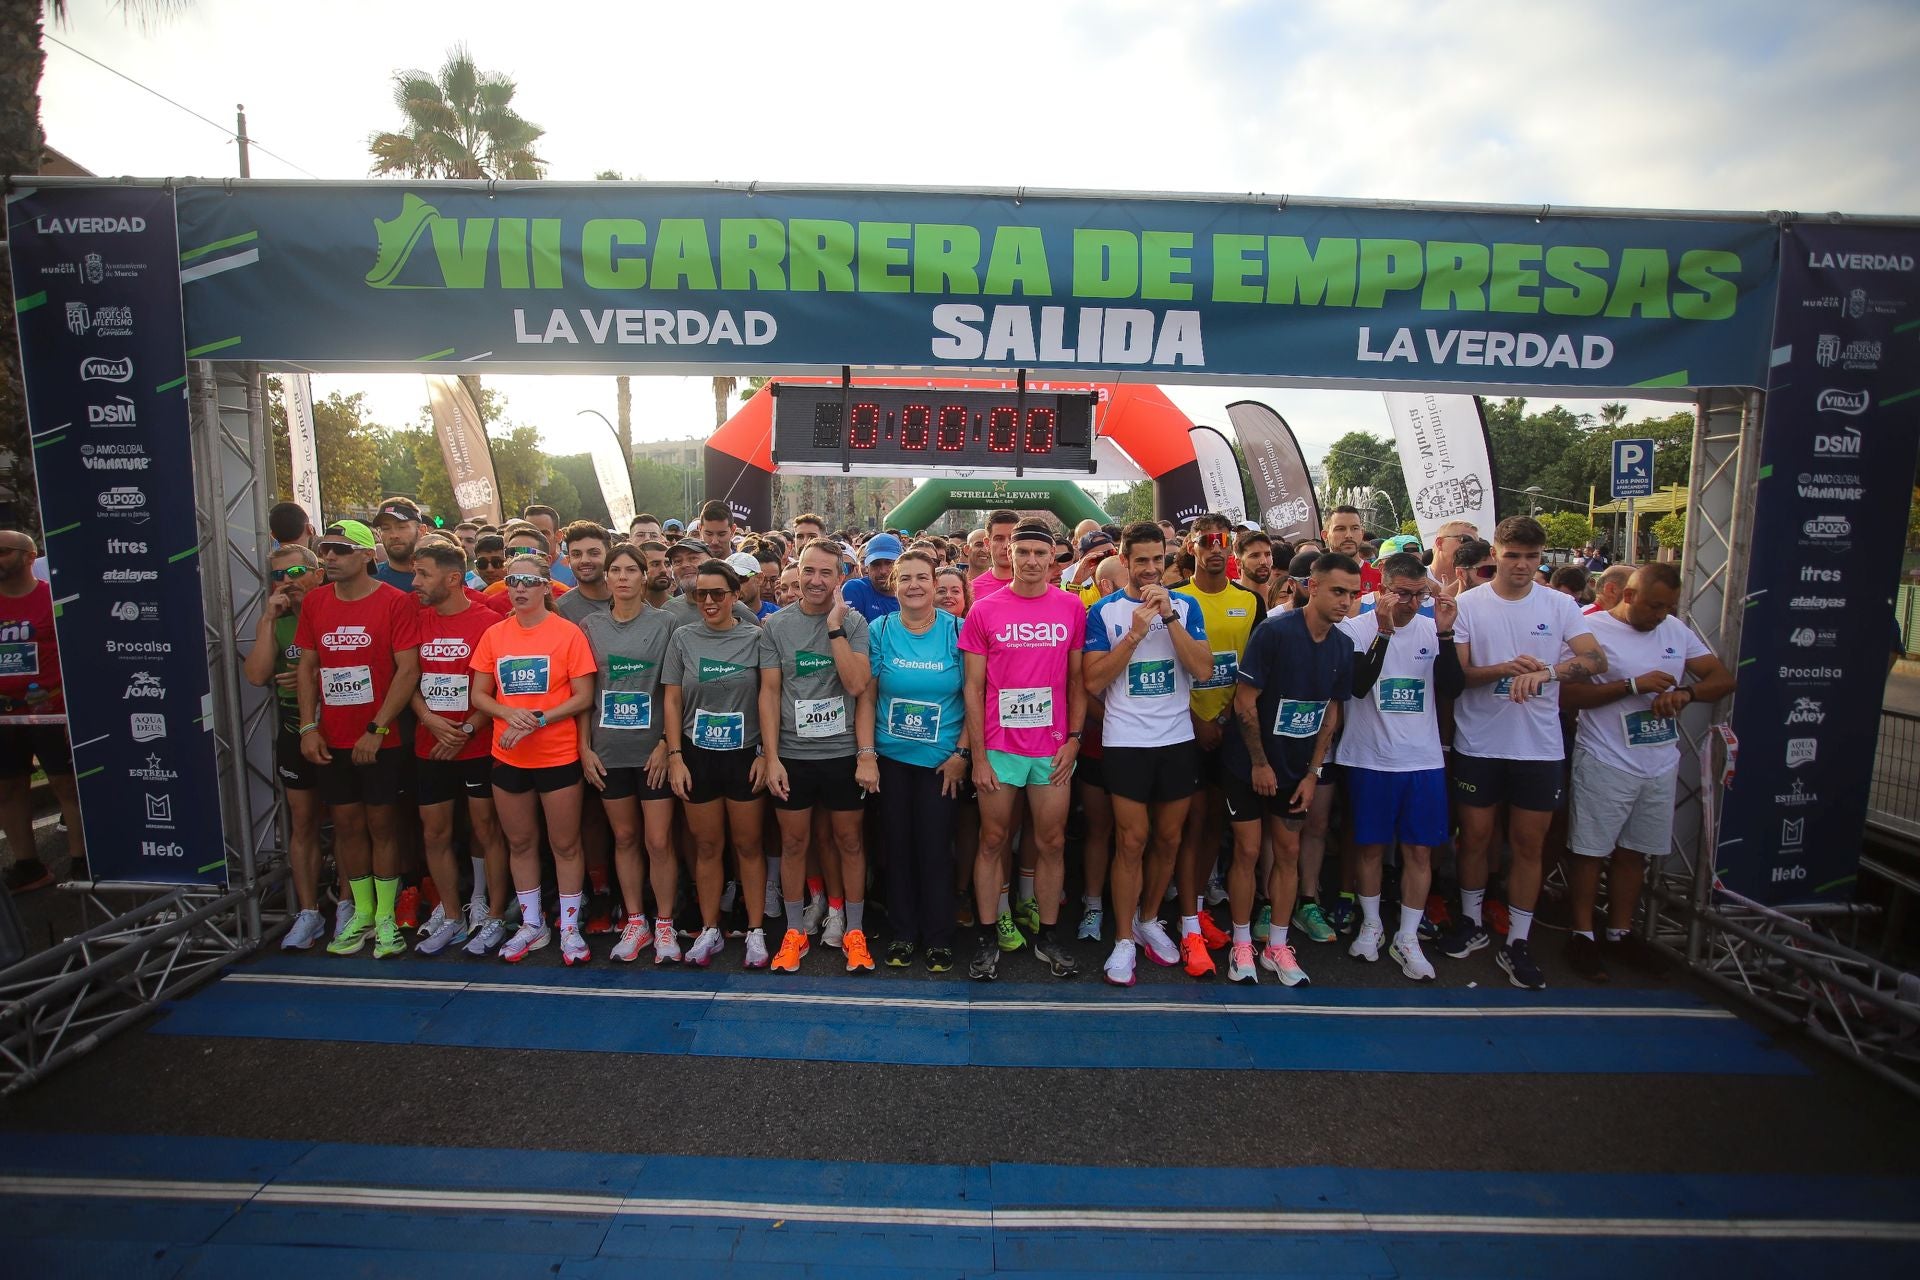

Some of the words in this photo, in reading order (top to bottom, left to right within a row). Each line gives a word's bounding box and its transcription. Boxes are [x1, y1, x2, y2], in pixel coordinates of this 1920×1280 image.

[36, 218, 64, 234] LA
[65, 217, 146, 233] VERDAD
[1808, 252, 1835, 268] LA
[1836, 254, 1914, 271] VERDAD
[581, 217, 1053, 297] CARRERA
[1072, 228, 1194, 301] DE
[1211, 233, 1742, 320] EMPRESAS
[513, 309, 579, 344] LA
[579, 309, 777, 346] VERDAD
[931, 303, 1205, 366] SALIDA
[1357, 327, 1419, 363] LA
[1425, 329, 1614, 370] VERDAD
[87, 364, 127, 376] VIDAL
[1825, 396, 1861, 407] VIDAL
[88, 404, 136, 423] DSM
[1814, 435, 1861, 453] DSM
[1620, 445, 1644, 473] P
[1007, 491, 1050, 499] LEVANTE
[107, 538, 147, 554] itres
[103, 569, 158, 582] atalayas
[1800, 566, 1841, 581] itres
[1790, 596, 1846, 609] atalayas
[105, 641, 171, 652] Brocalsa
[511, 669, 535, 681] 198
[1140, 672, 1165, 683] 613
[1779, 666, 1842, 678] Brocalsa
[328, 681, 361, 692] 2056
[428, 686, 458, 696] 2053
[1392, 689, 1416, 700] 537
[613, 703, 638, 714] 308
[1010, 703, 1043, 714] 2114
[806, 711, 837, 723] 2049
[905, 714, 922, 726] 68
[1292, 711, 1315, 724] 243
[136, 724, 162, 732] DEUS
[705, 726, 731, 737] 307
[1640, 719, 1667, 732] 534
[1791, 741, 1814, 749] AQUA
[129, 769, 178, 778] ESTRELLA
[1775, 793, 1818, 803] ESTRELLA
[142, 842, 183, 857] Hero
[1772, 865, 1806, 882] Hero
